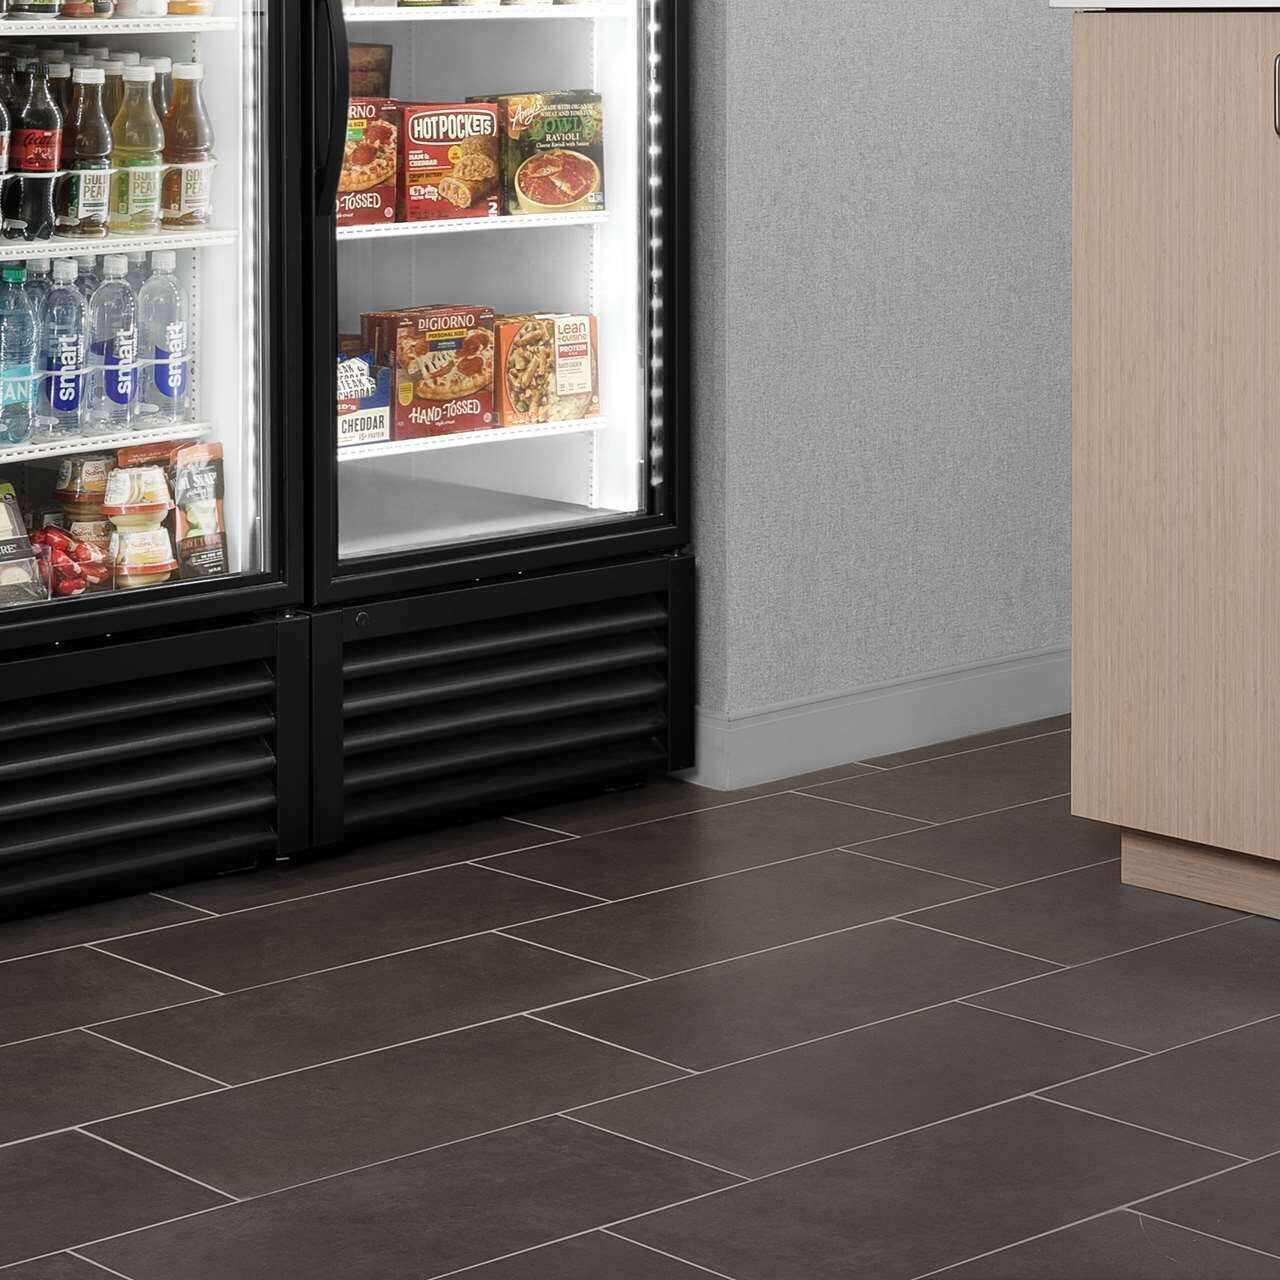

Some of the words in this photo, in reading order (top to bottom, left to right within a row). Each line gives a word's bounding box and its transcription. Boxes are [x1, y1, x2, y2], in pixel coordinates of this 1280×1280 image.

[414, 116, 439, 139] HOT
[439, 114, 491, 140] POCKETS
[509, 103, 544, 130] Amy's
[545, 133, 580, 142] RAVIOLI
[488, 202, 498, 214] 2
[558, 322, 587, 334] Lean
[117, 324, 134, 395] smart
[166, 322, 183, 388] smart
[559, 344, 587, 353] PROTEIN
[60, 334, 78, 401] smart
[341, 415, 385, 433] CHEDDAR
[409, 399, 481, 425] HAND-TOSSED
